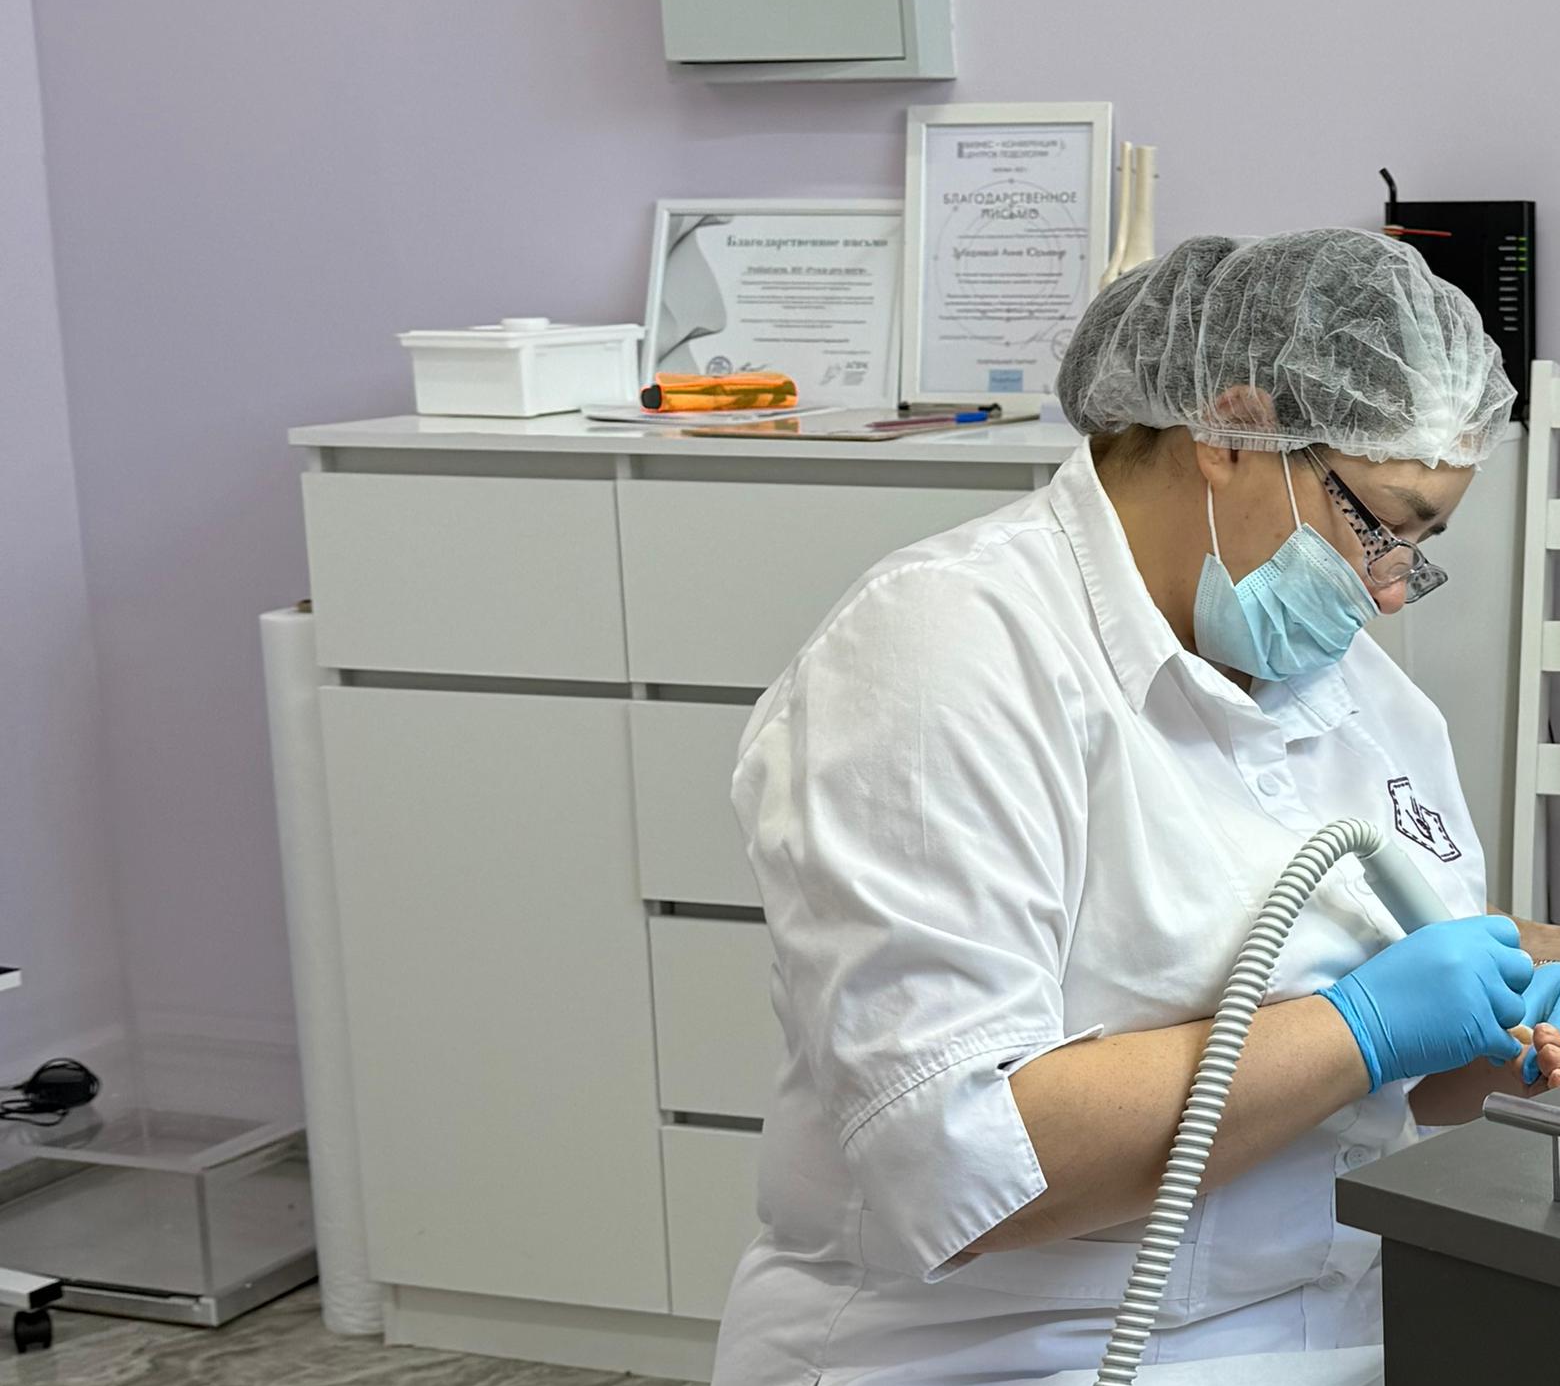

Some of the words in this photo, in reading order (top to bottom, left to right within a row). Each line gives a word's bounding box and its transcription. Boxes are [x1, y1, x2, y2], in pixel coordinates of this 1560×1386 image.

[943, 192, 1078, 206] БЛАГОДАРСТВЕННОЕ
[980, 208, 1040, 220] ПИСЬМО
[727, 235, 840, 251] Благодарственное
